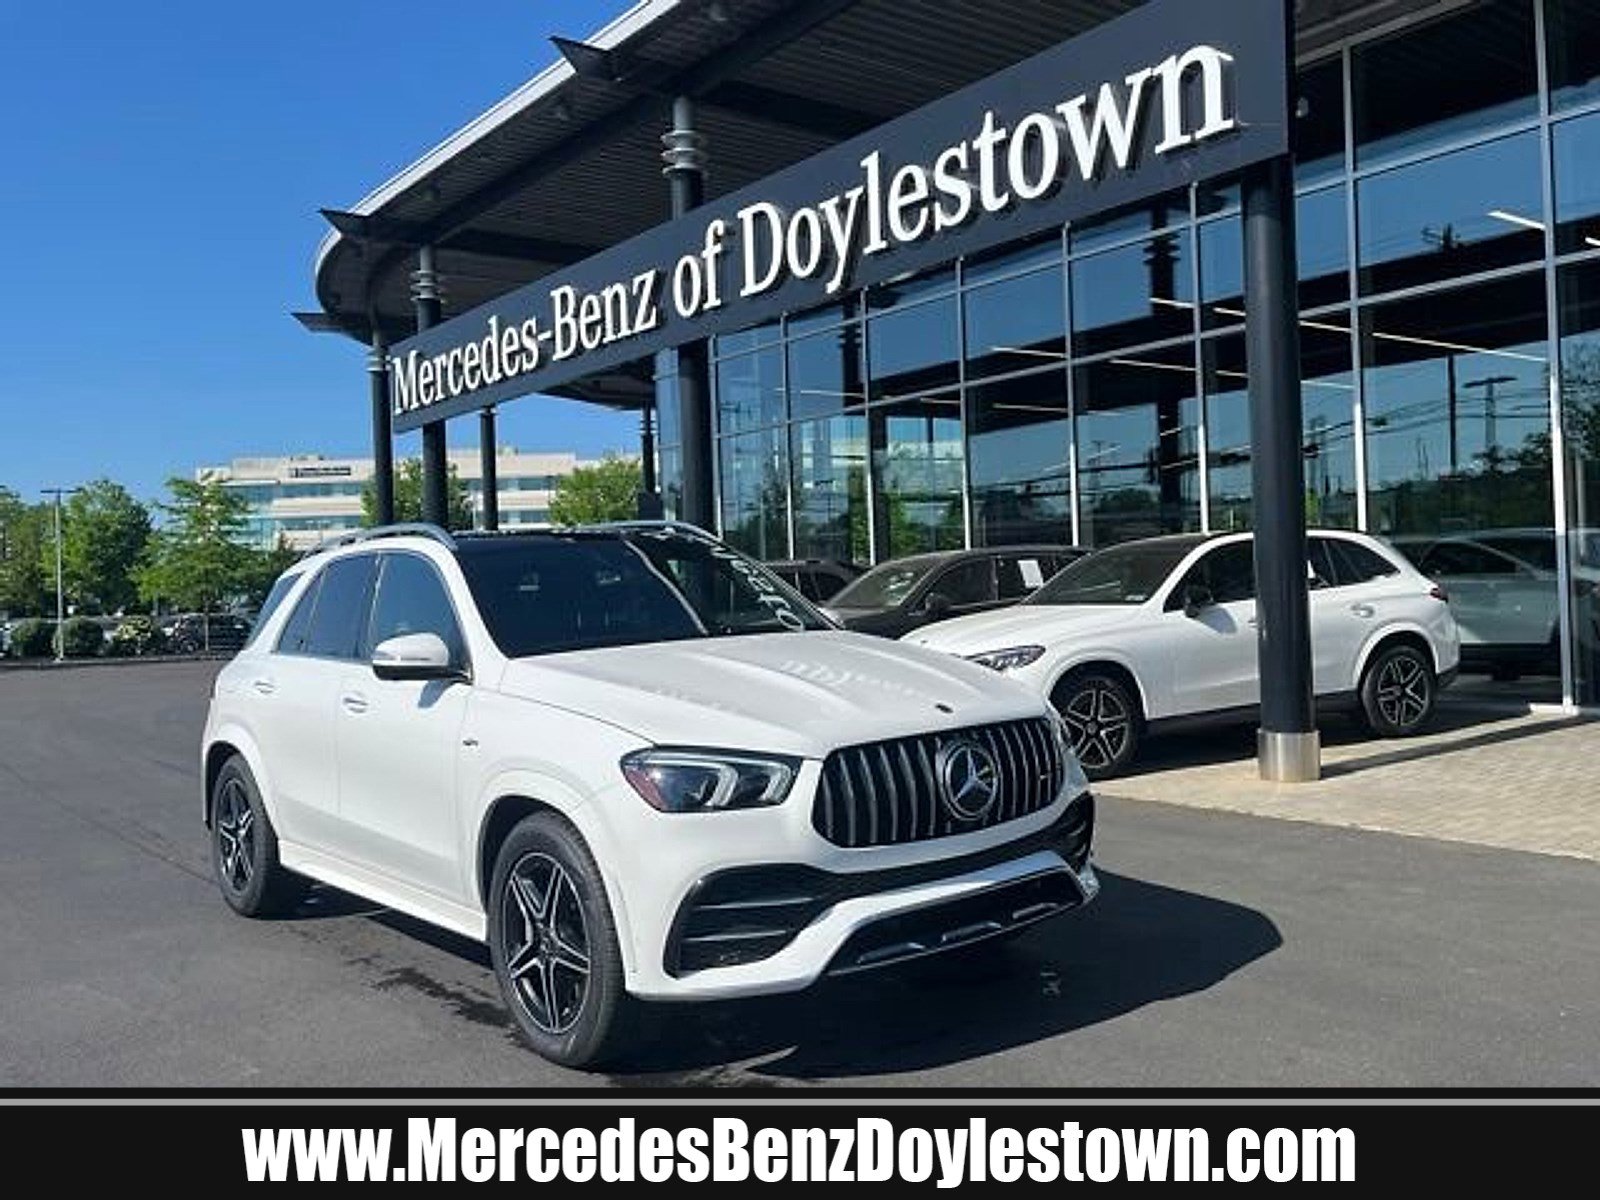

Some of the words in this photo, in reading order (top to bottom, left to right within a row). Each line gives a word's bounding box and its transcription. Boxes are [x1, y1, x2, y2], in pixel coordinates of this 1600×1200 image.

[391, 269, 657, 416] Mercedes-Benz
[672, 219, 725, 319] of
[737, 43, 1235, 298] Doylestown
